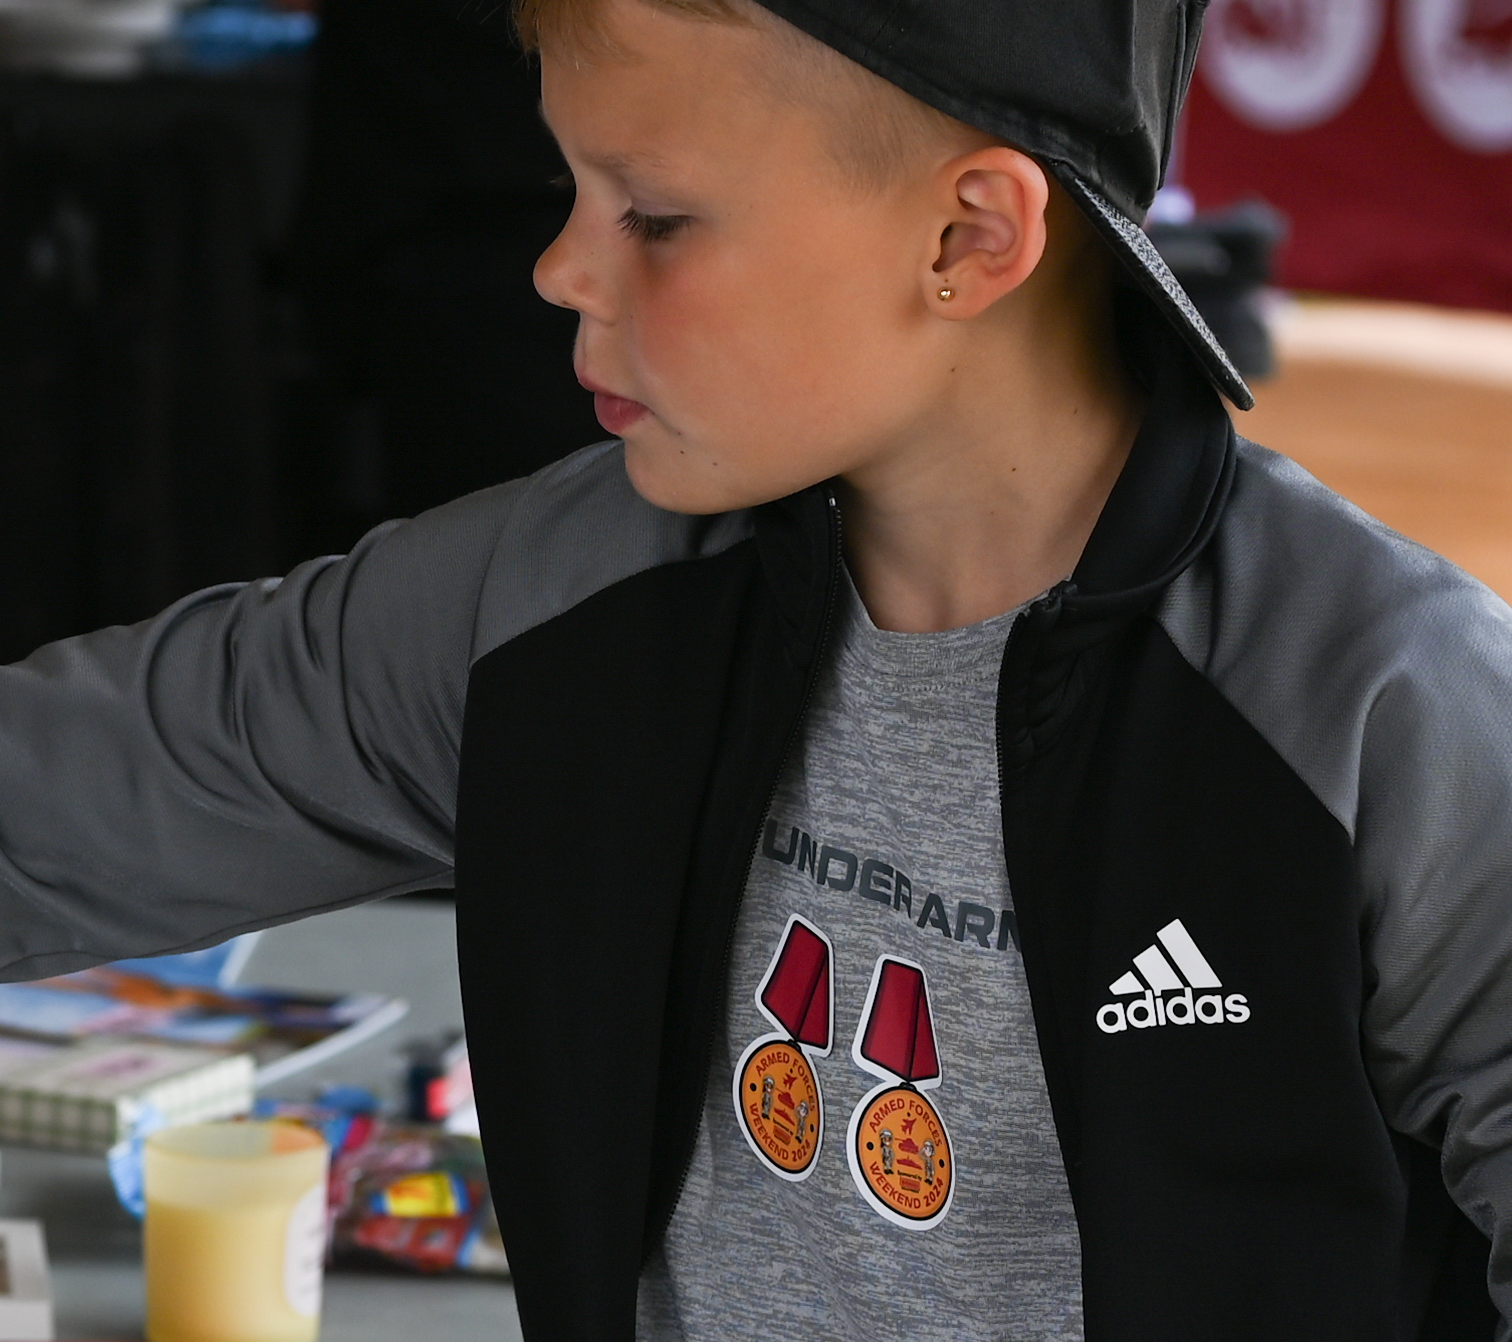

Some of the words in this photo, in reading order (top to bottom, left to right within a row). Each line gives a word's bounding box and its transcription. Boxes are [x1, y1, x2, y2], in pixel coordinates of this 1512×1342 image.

[1095, 987, 1251, 1034] adidas
[755, 1051, 790, 1077] ARMED
[792, 1058, 816, 1112] FORCES
[749, 1102, 789, 1161] WEEKEND
[791, 1139, 812, 1162] 2024
[869, 1098, 906, 1133] ARMED
[908, 1099, 943, 1147] FORCES
[869, 1161, 921, 1209] WEEKEND
[923, 1177, 943, 1207] 2024
